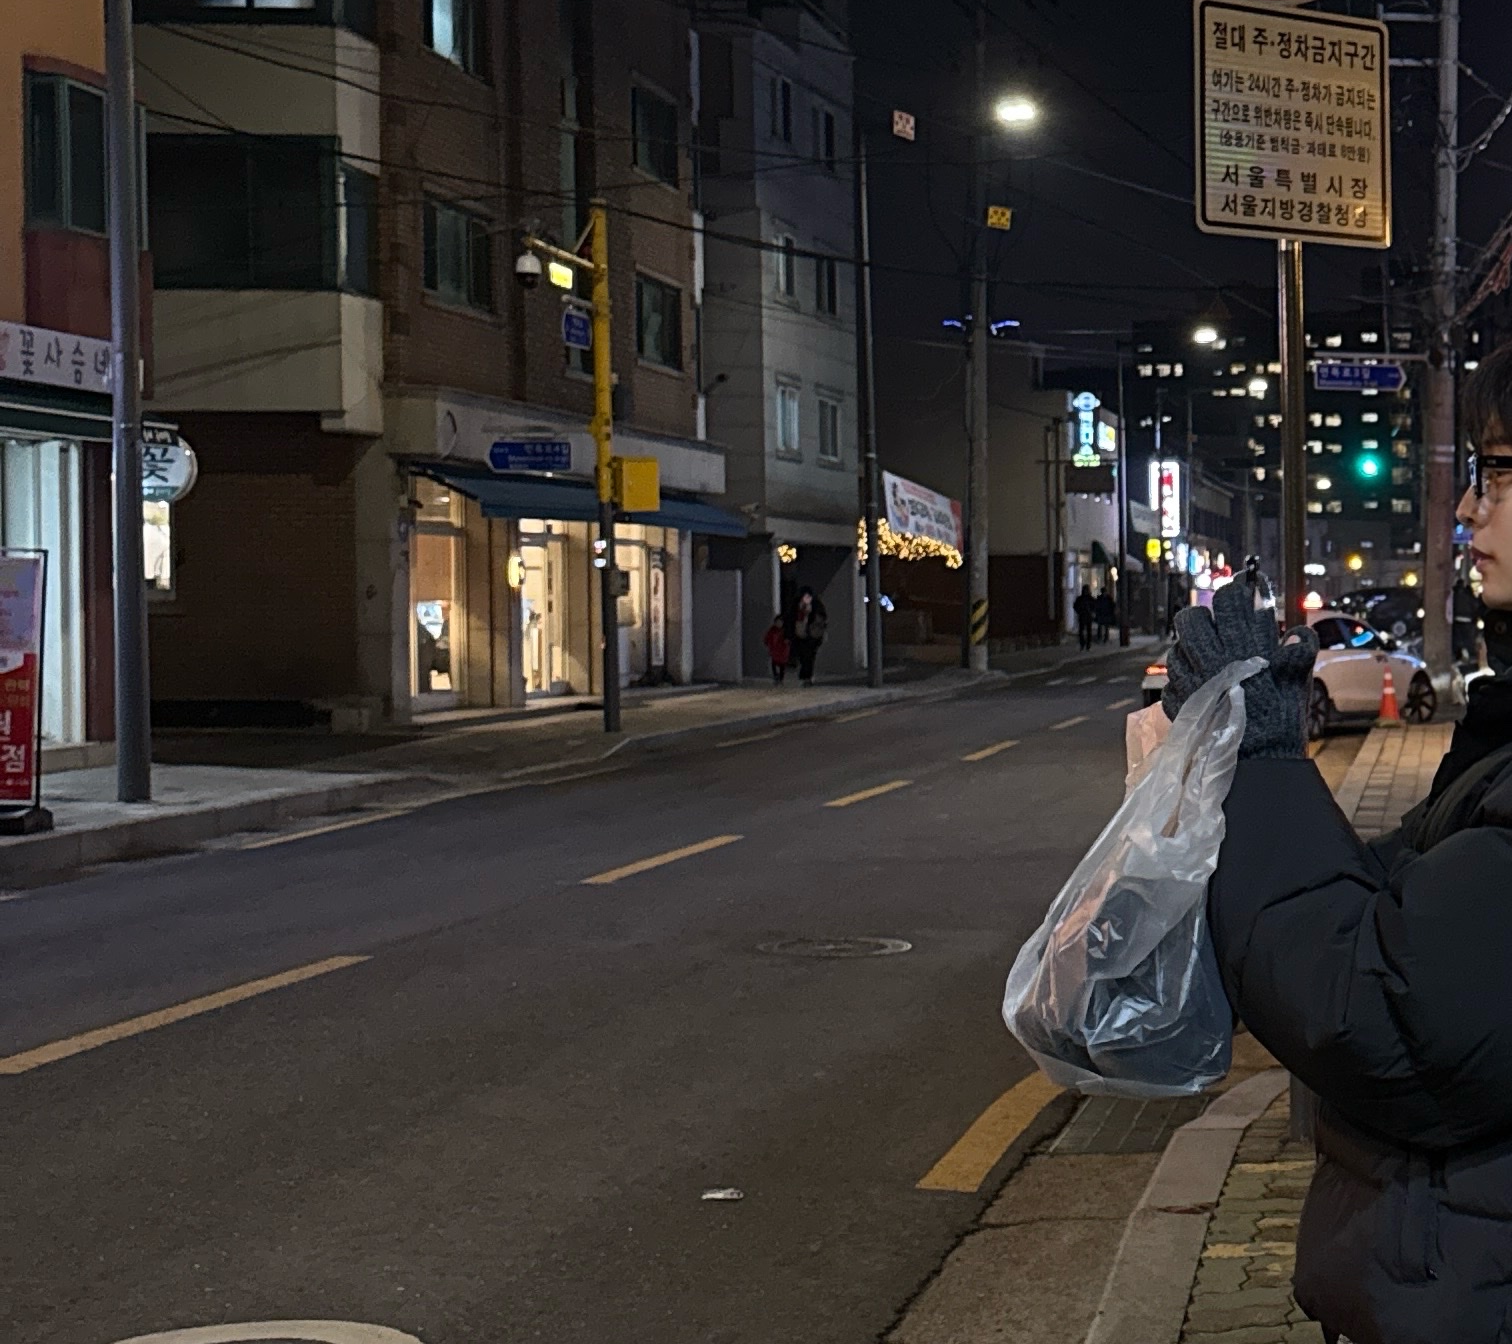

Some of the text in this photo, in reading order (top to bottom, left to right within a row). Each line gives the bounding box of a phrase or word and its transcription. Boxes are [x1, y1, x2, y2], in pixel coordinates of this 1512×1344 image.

[1212, 21, 1246, 53] 절대
[1211, 68, 1245, 94] 여기는
[1248, 73, 1282, 99] 24시간
[1335, 84, 1377, 112] 금지되는
[1211, 99, 1251, 123] 구간으로
